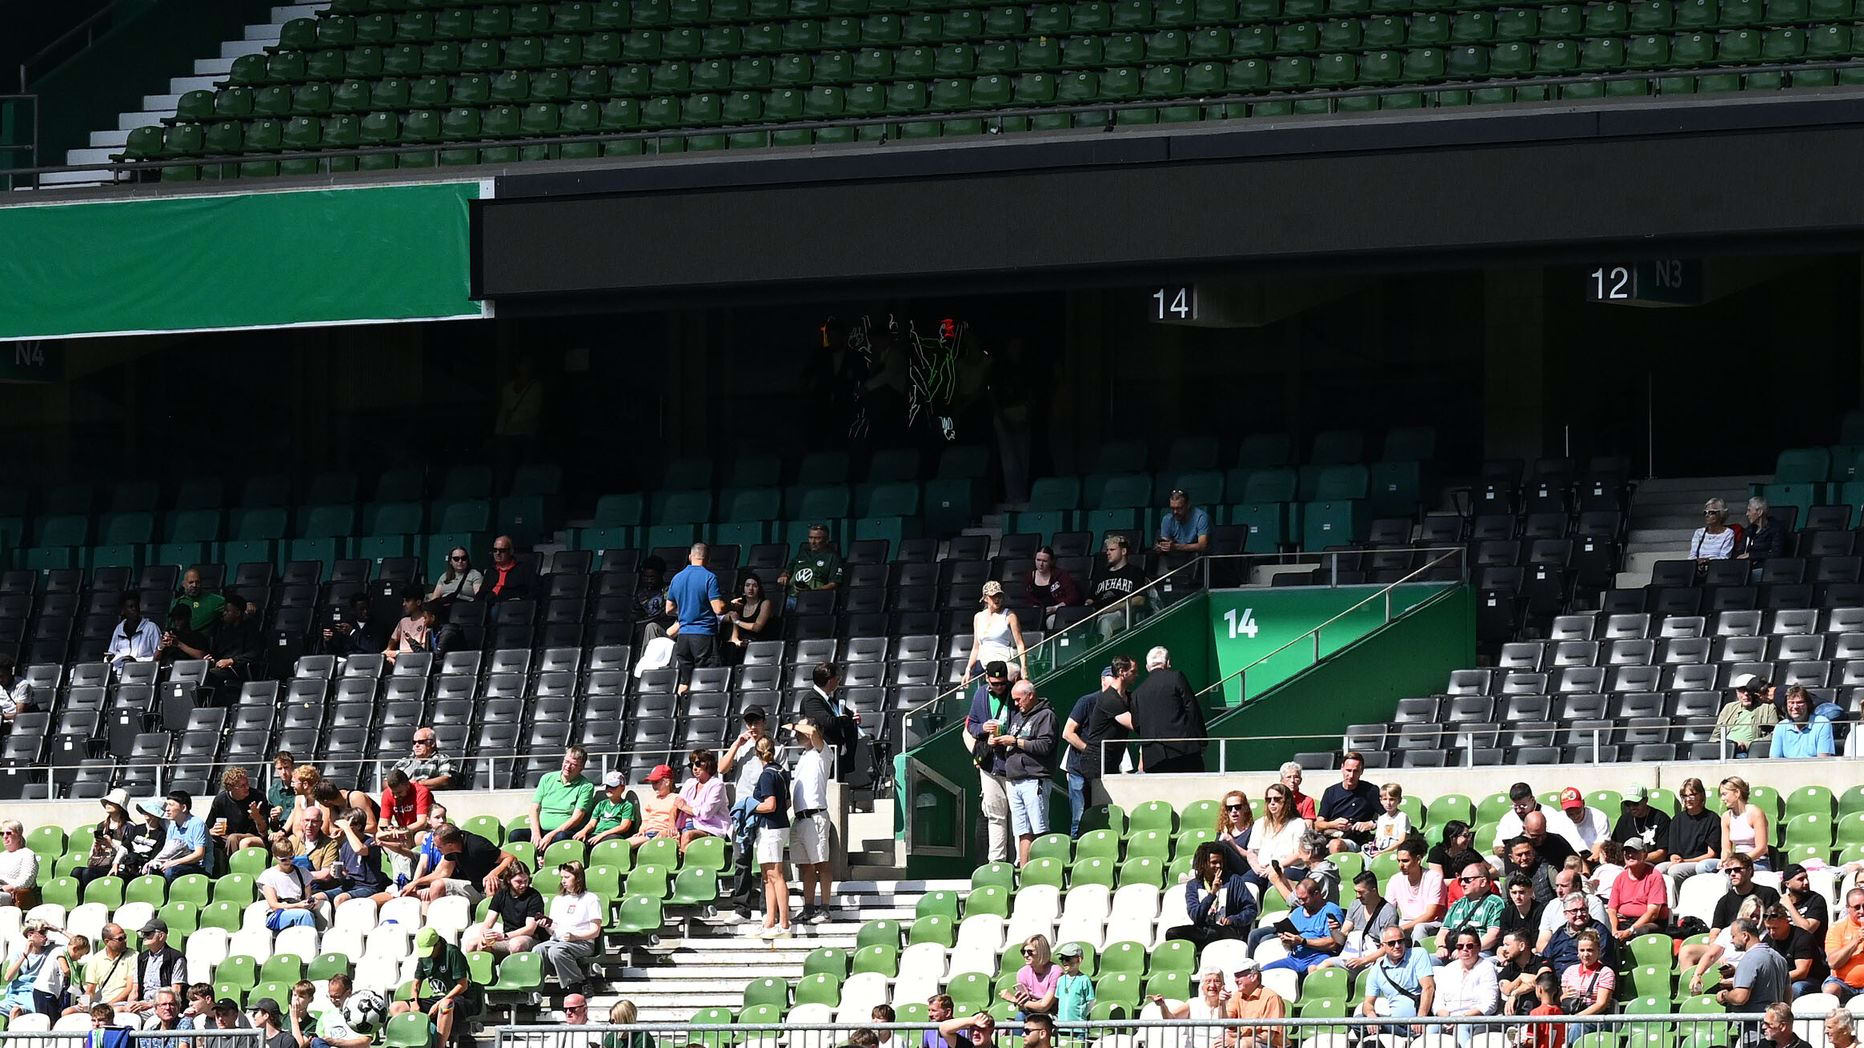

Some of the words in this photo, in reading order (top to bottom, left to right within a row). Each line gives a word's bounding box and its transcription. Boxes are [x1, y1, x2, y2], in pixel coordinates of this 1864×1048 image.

[1591, 267, 1629, 299] 12
[1655, 259, 1683, 288] N3
[1152, 288, 1189, 320] 14
[16, 340, 45, 367] N4
[1223, 608, 1258, 639] 14
